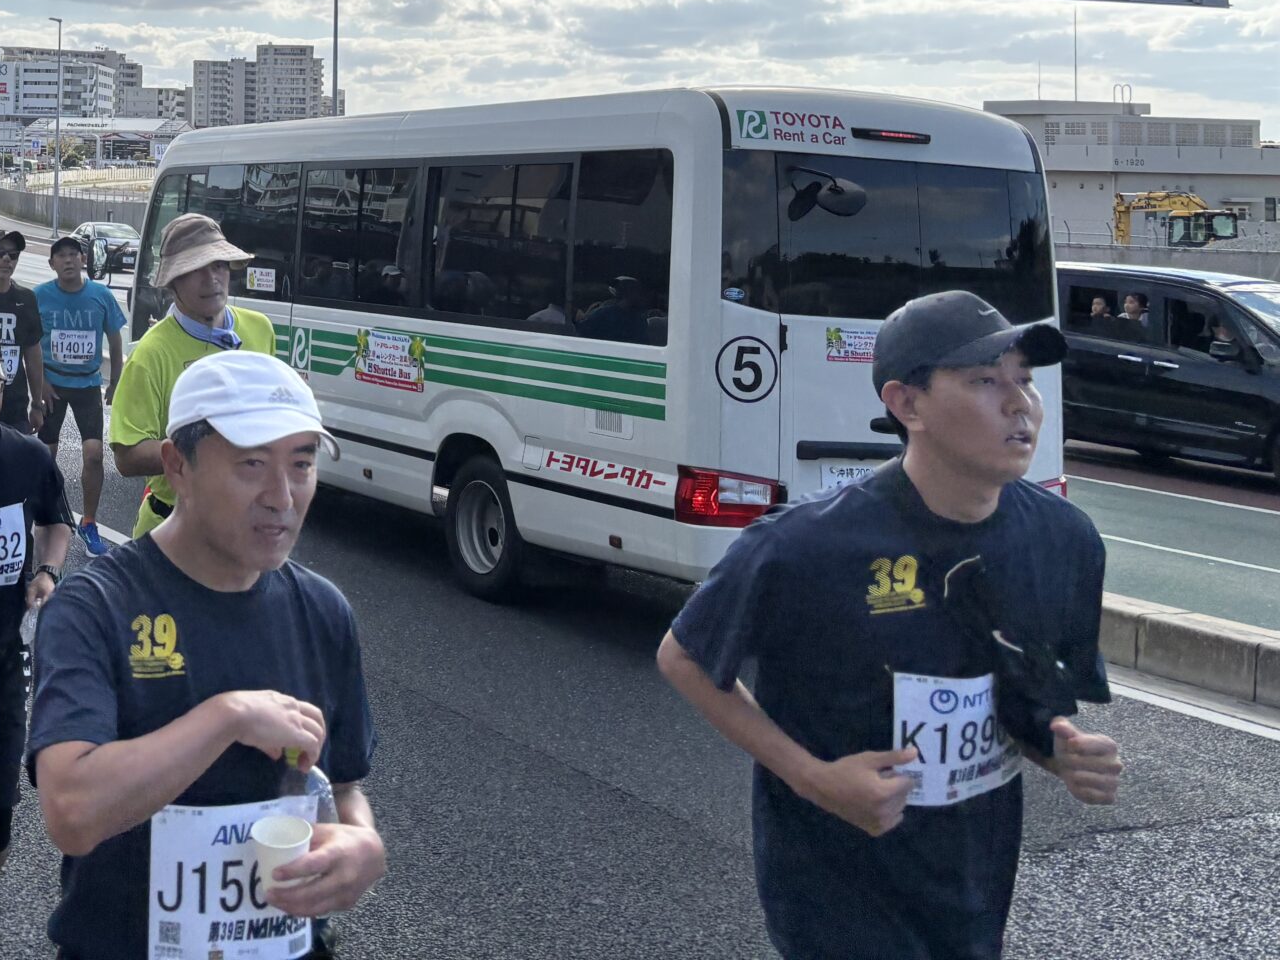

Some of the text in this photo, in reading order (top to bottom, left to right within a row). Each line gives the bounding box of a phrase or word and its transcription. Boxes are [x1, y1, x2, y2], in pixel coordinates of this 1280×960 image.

[769, 110, 846, 131] TOYOTA
[773, 127, 847, 146] Rent a Car
[50, 308, 96, 328] TMT
[51, 341, 94, 355] H14012
[373, 363, 412, 380] Shuttle Bus
[545, 450, 667, 490] トヨタレンタカー
[867, 554, 918, 597] 39
[130, 613, 177, 658] 39
[157, 859, 268, 919] J156
